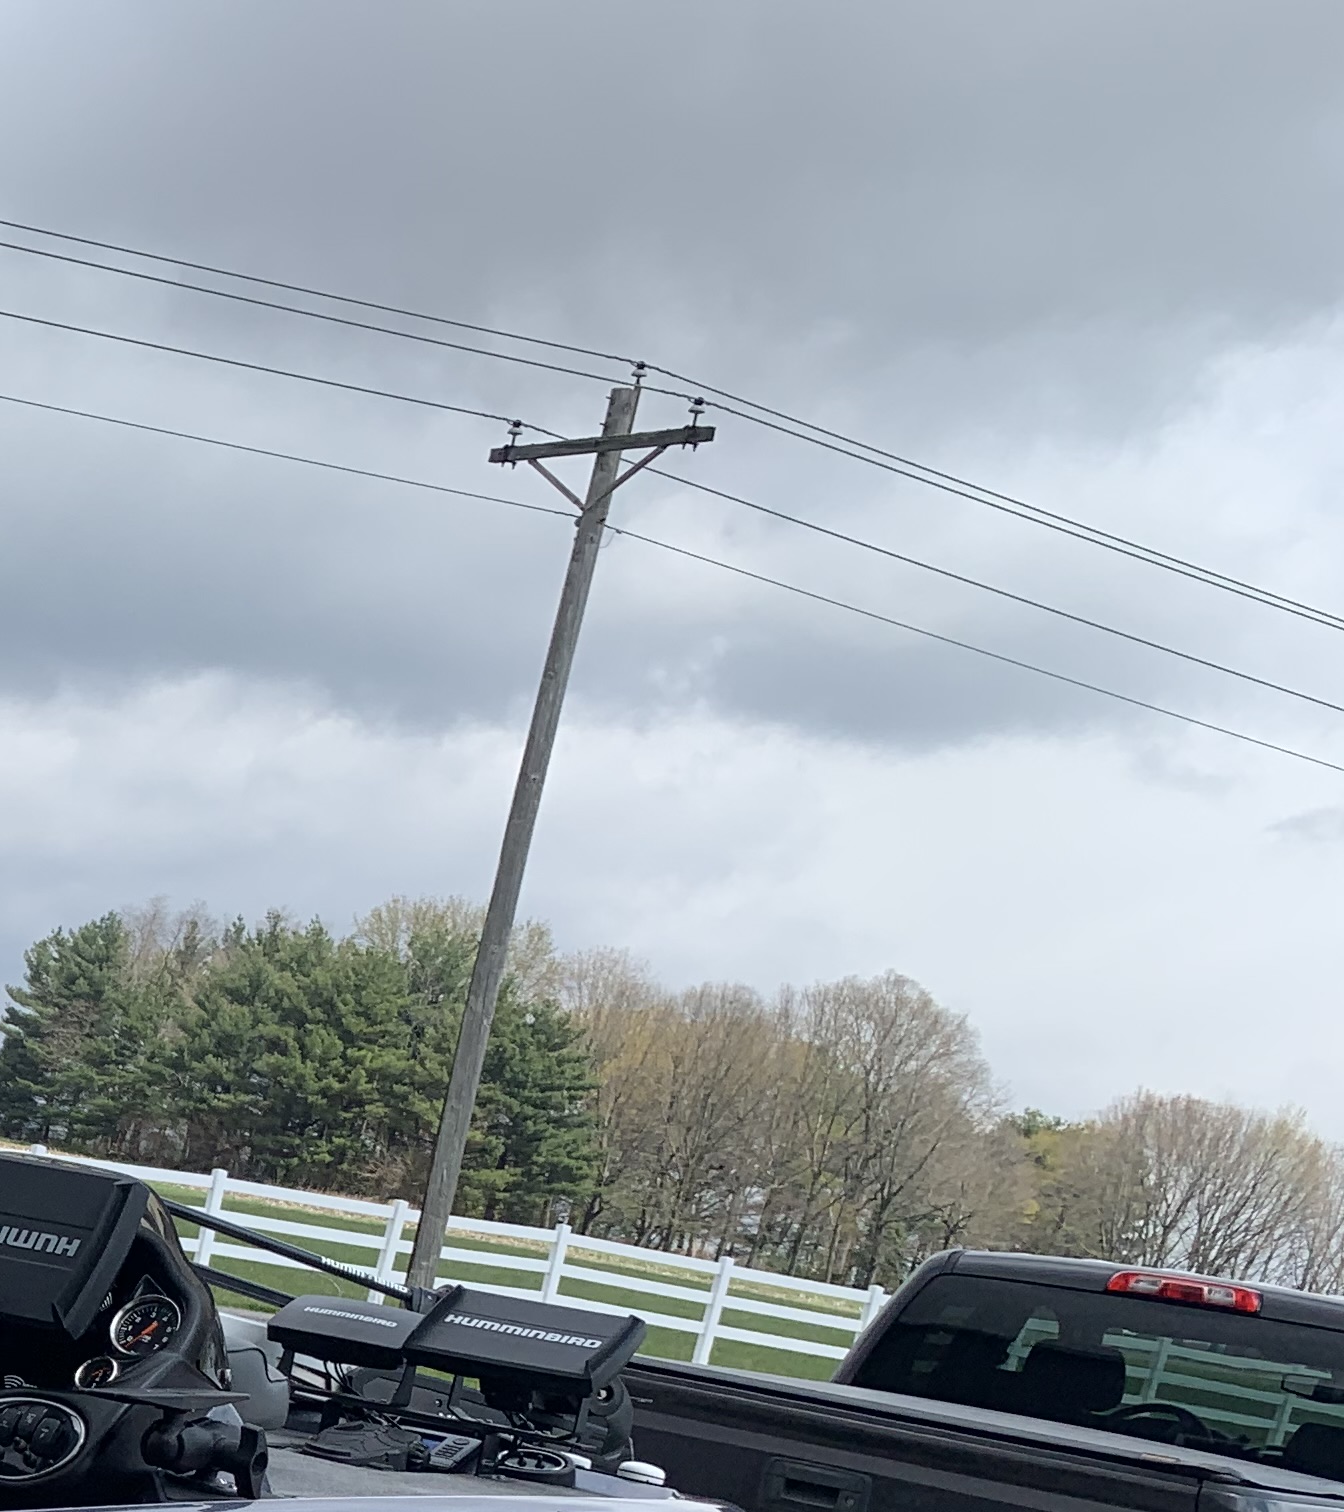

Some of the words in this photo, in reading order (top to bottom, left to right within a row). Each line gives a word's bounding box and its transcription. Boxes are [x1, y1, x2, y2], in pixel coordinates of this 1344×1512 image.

[321, 1255, 409, 1294] HUMMINBIRD
[304, 1305, 398, 1328] HUMMINBIRD
[444, 1313, 603, 1349] HUMMINBIRD
